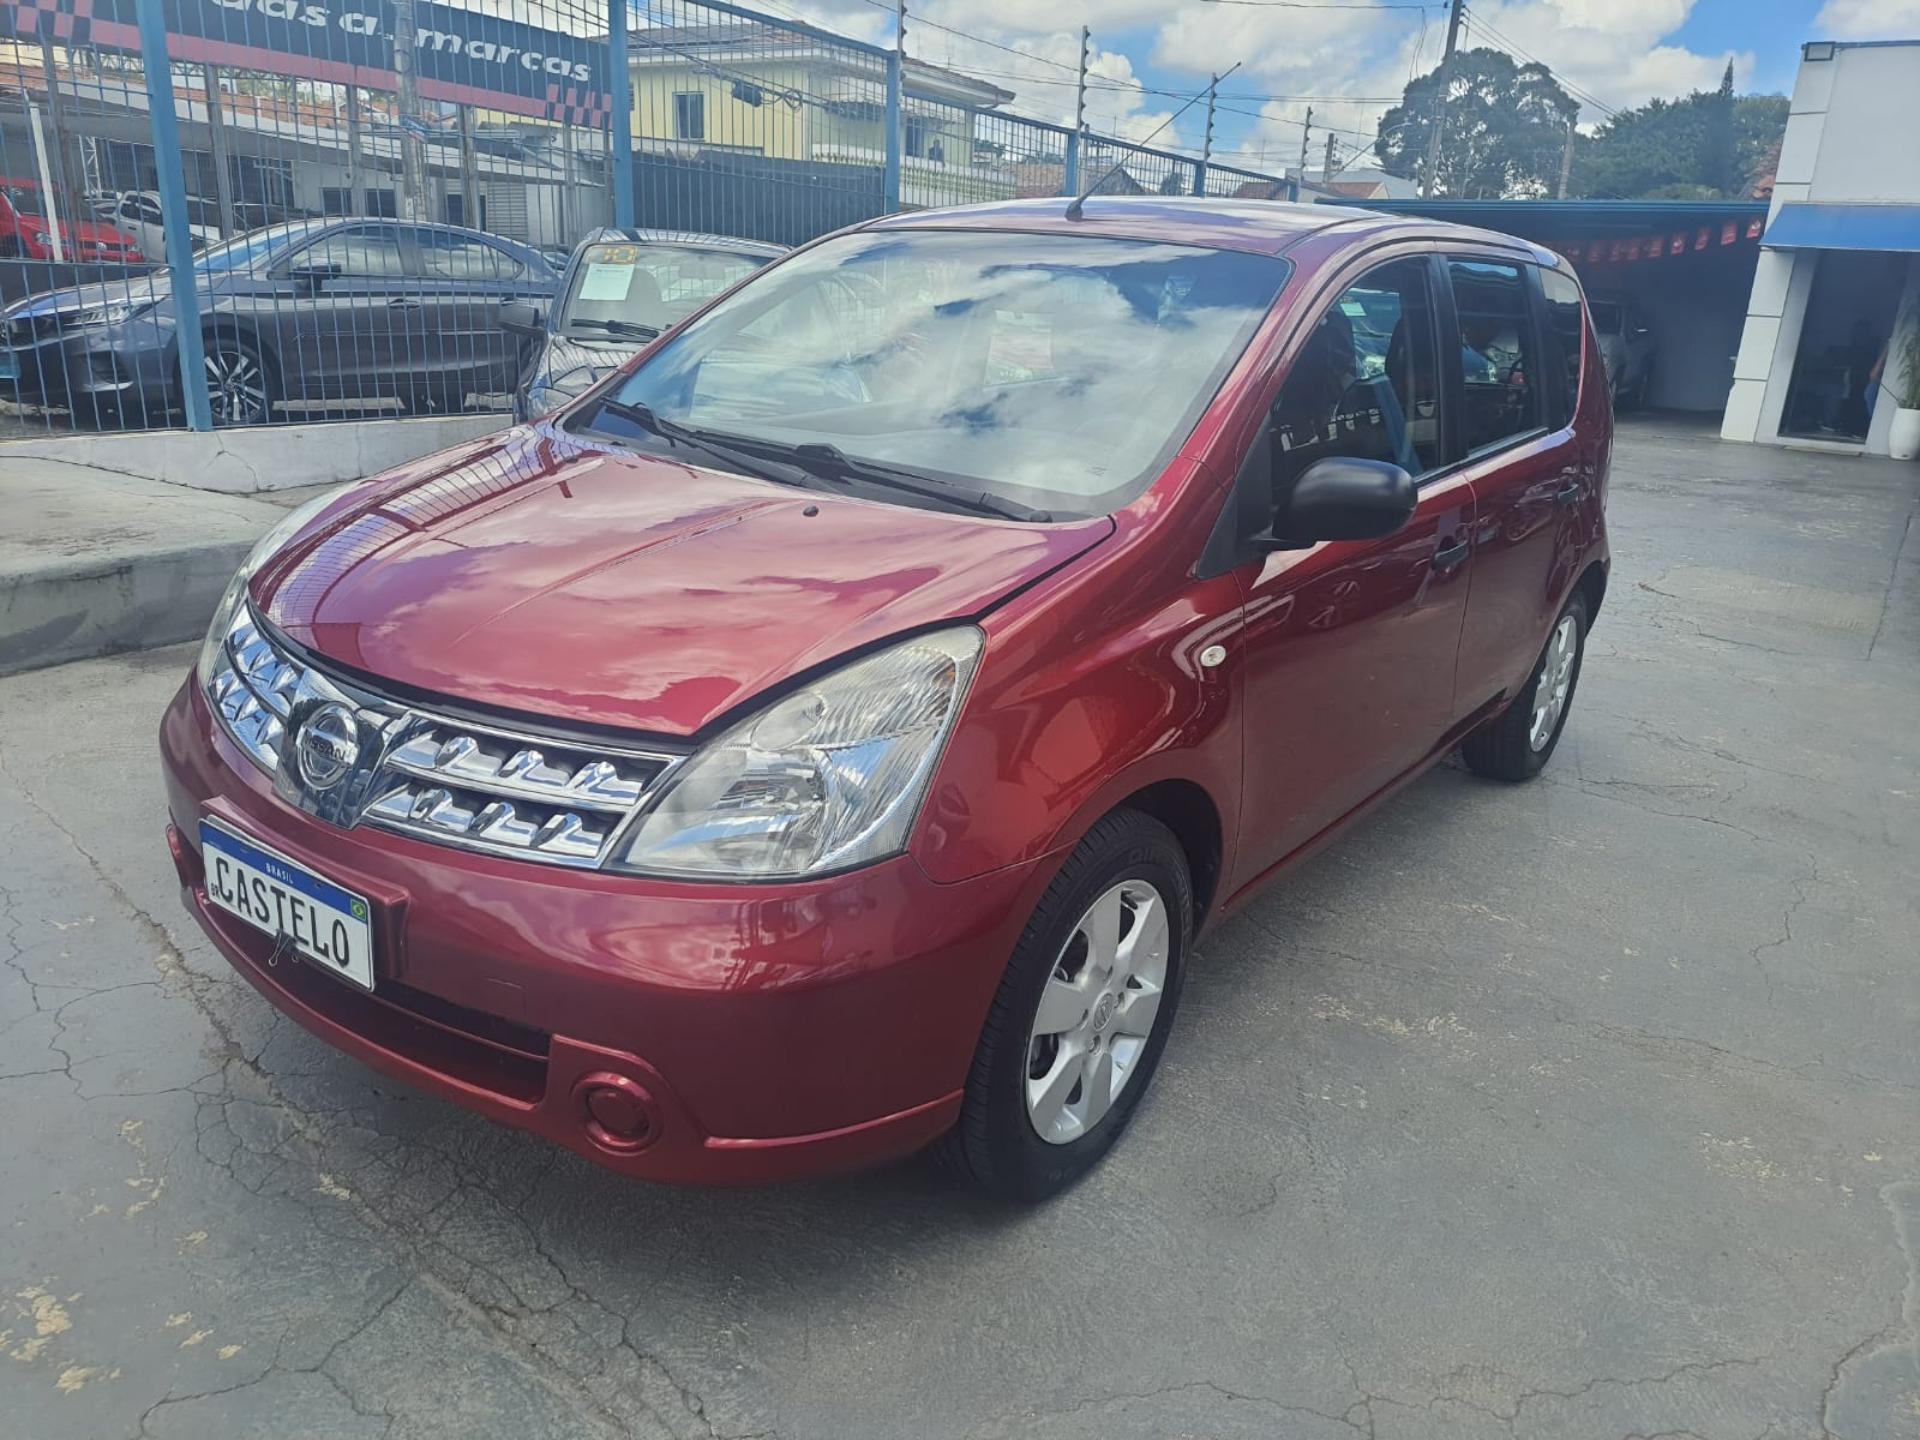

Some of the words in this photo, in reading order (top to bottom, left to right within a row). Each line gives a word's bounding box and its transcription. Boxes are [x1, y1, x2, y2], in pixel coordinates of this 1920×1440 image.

[414, 28, 591, 82] marcas
[265, 862, 294, 884] BRASIL
[216, 857, 350, 968] CASTELO
